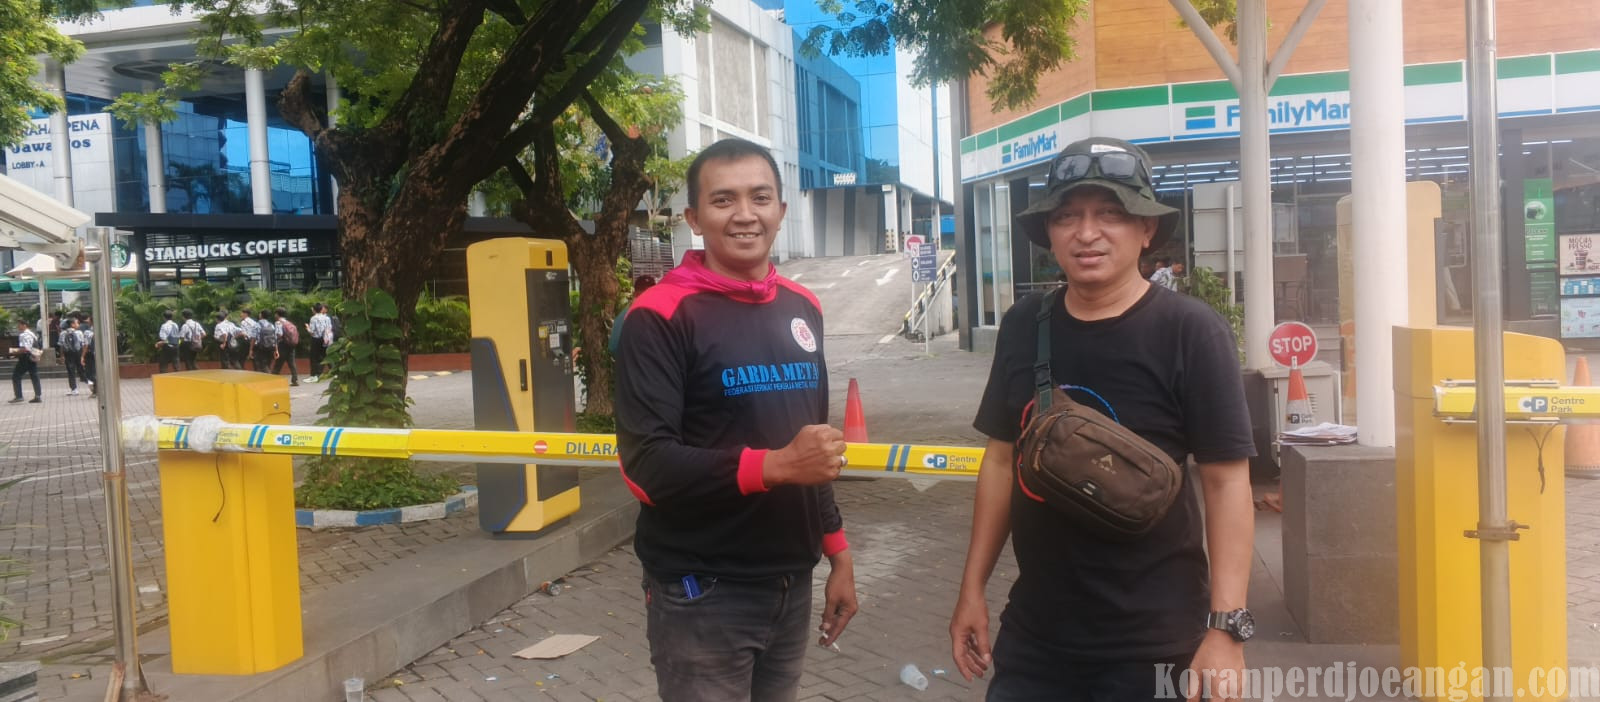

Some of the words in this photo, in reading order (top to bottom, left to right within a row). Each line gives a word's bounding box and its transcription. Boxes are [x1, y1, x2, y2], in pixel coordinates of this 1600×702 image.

[1013, 131, 1057, 160] FamilyMart
[145, 241, 241, 262] STARBUCKS
[245, 238, 308, 255] COFFEE
[1272, 335, 1313, 354] STOP
[721, 364, 781, 389] GARDA
[1551, 396, 1585, 405] Centre
[1551, 405, 1573, 413] Park
[949, 454, 977, 463] Centre
[949, 463, 967, 472] Park
